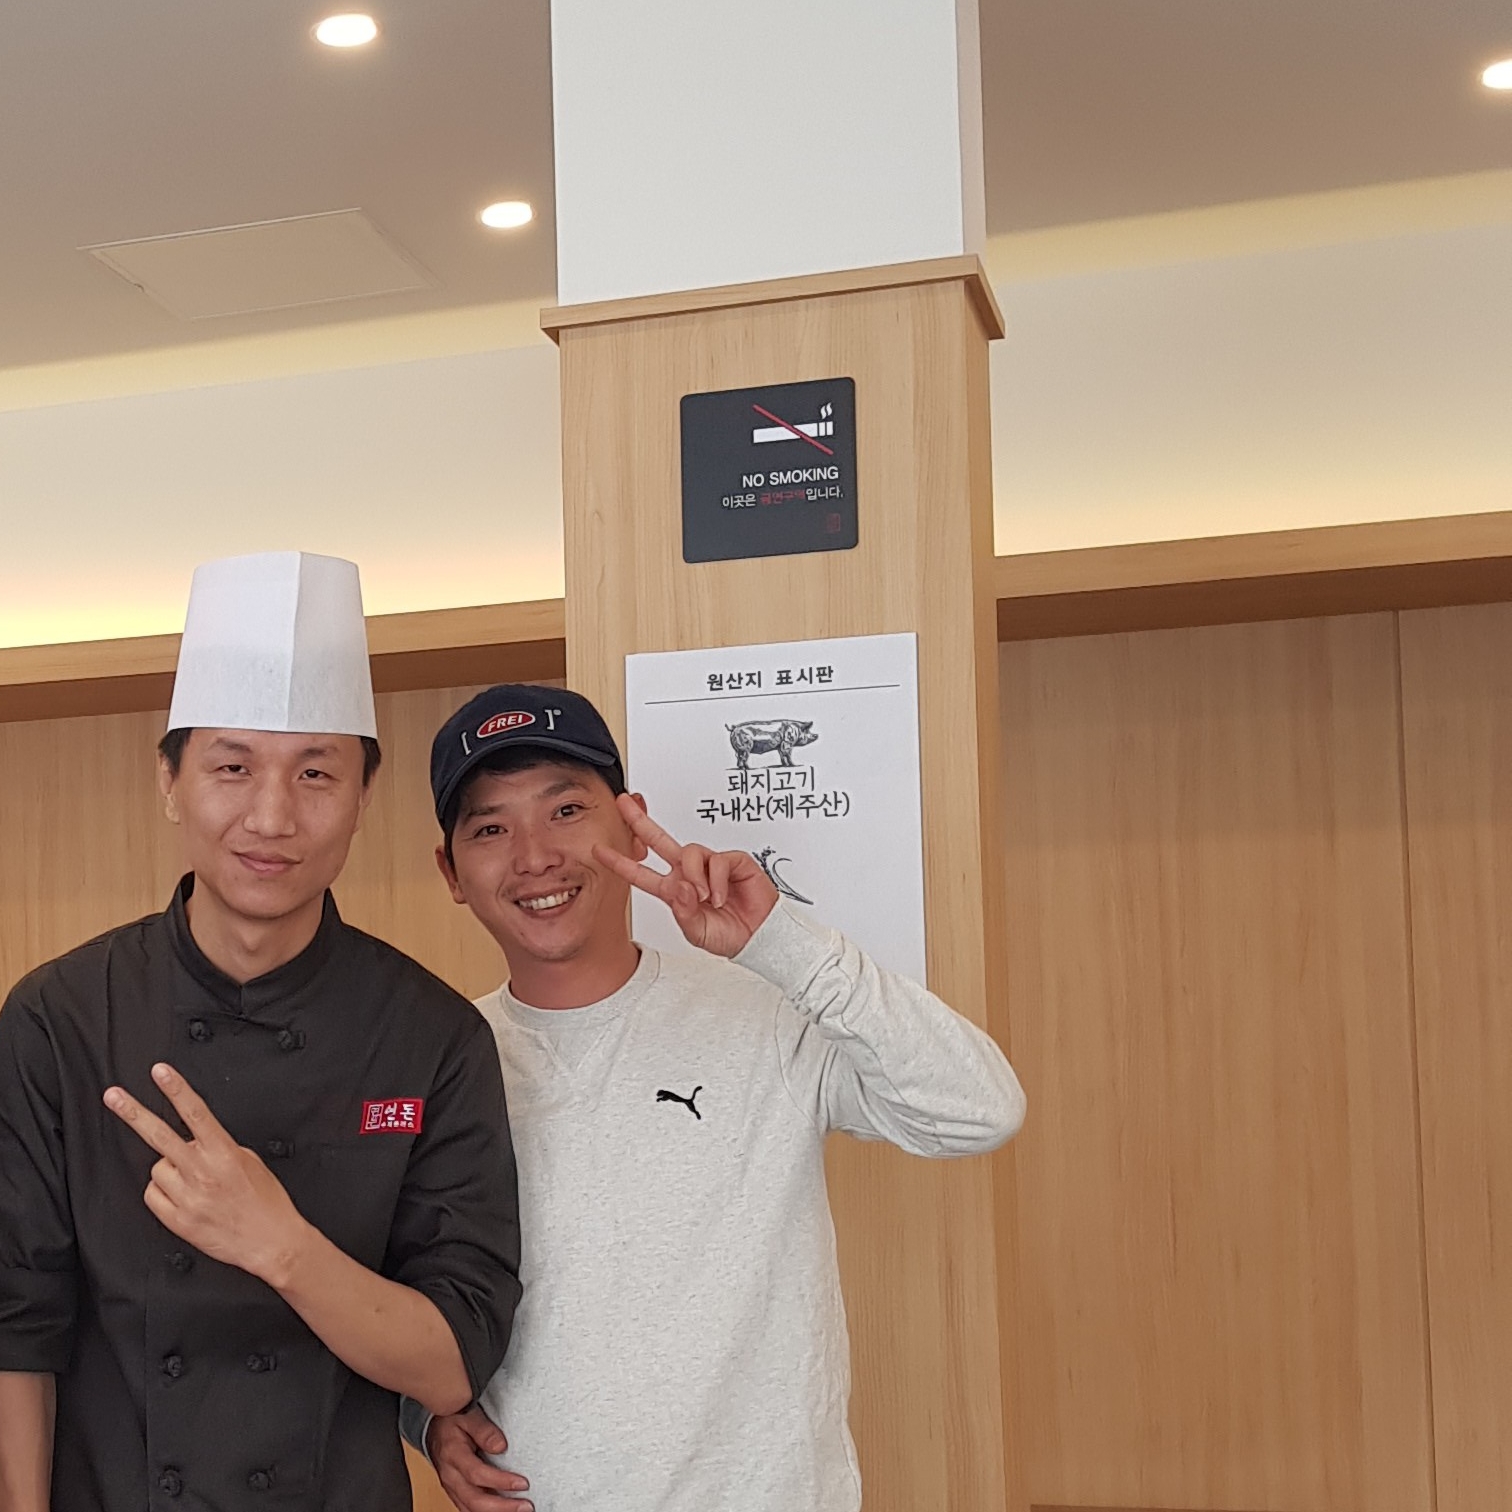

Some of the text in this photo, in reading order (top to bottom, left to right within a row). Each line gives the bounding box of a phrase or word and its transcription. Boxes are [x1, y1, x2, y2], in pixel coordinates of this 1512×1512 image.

[742, 465, 840, 489] NO SMOKING
[721, 493, 756, 509] 이곳은
[706, 665, 834, 691] 원산지 표시판
[487, 714, 523, 734] FREI
[727, 765, 815, 795] 돼지고기
[696, 790, 850, 824] 국내산(제주산)
